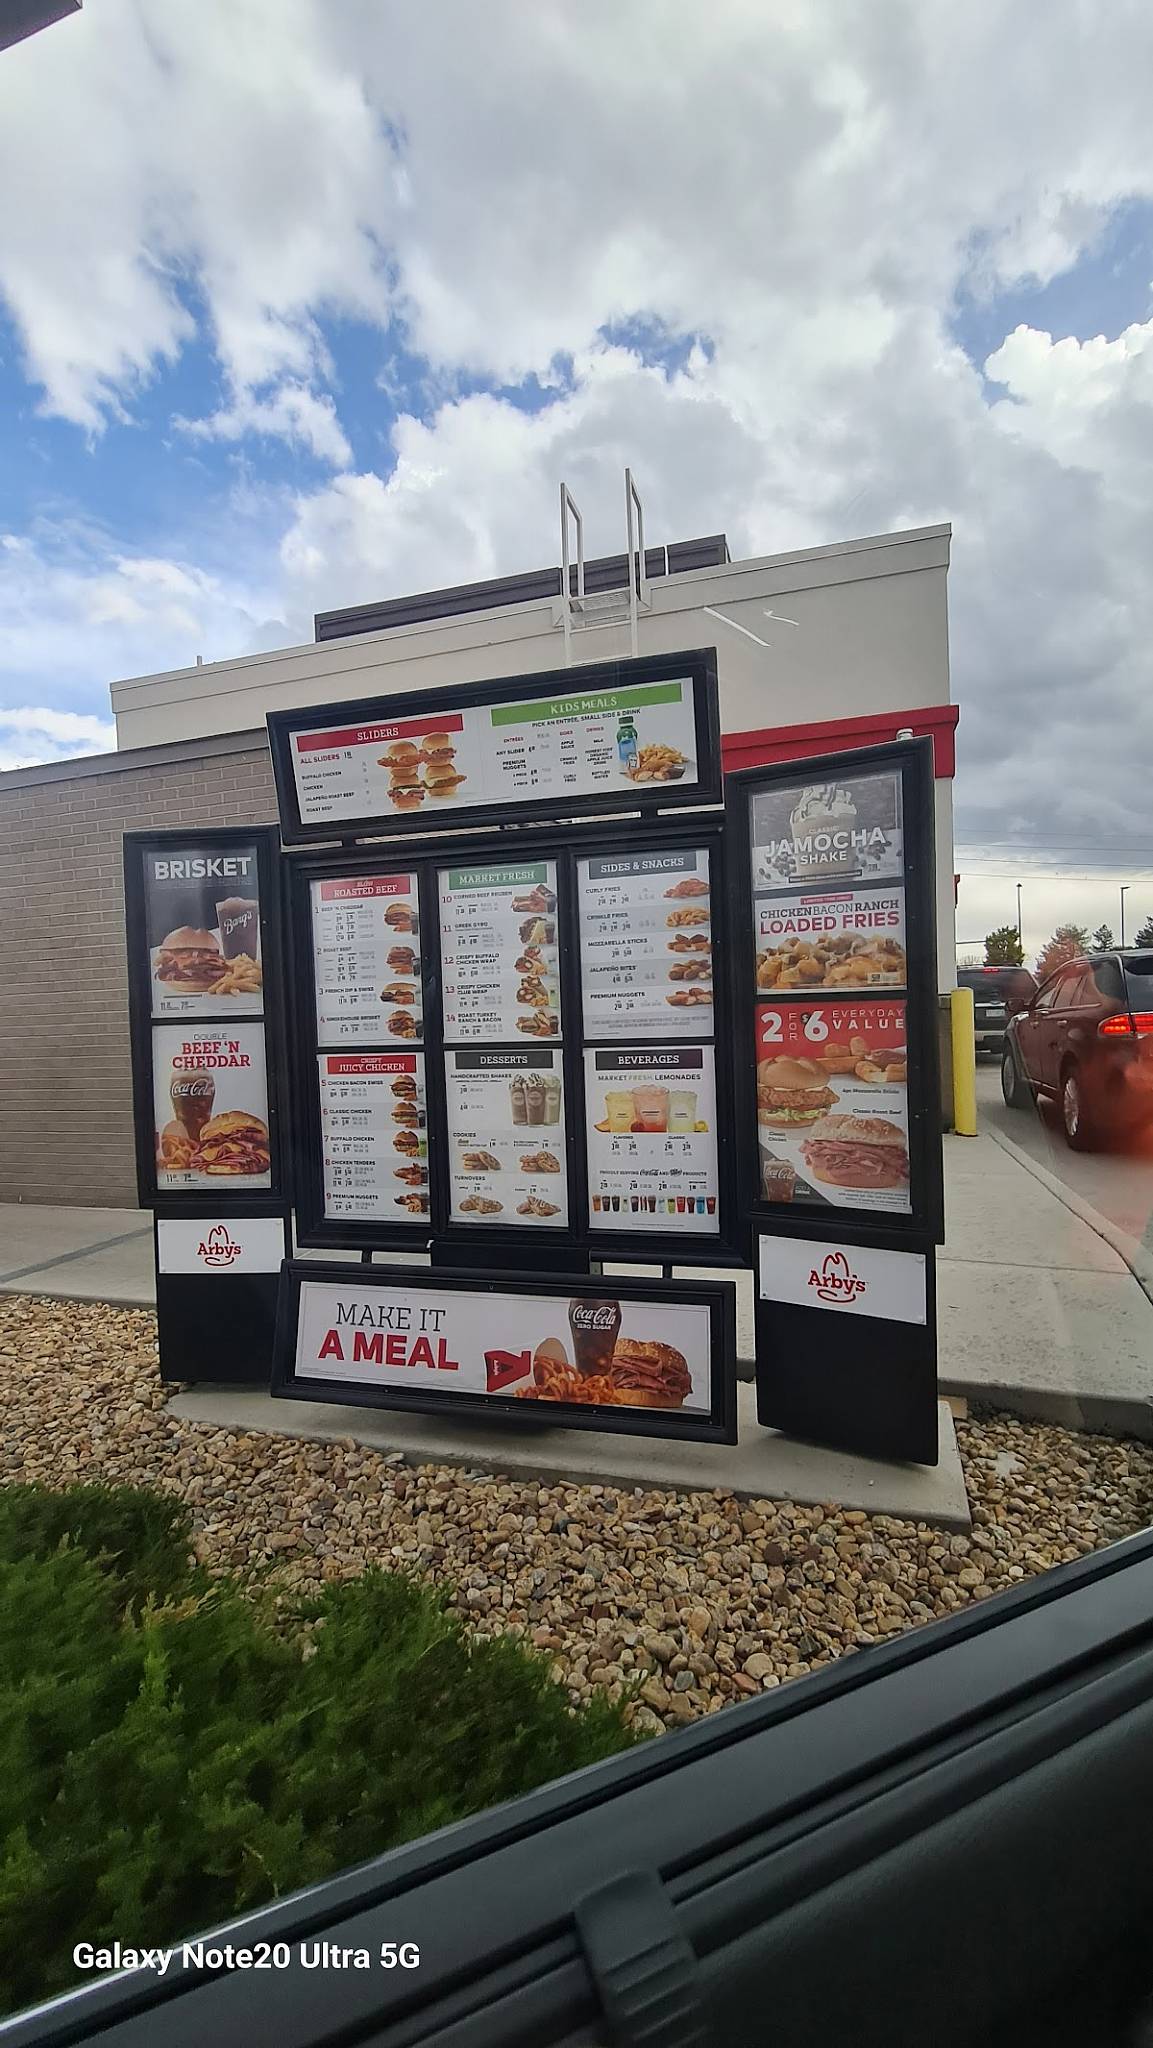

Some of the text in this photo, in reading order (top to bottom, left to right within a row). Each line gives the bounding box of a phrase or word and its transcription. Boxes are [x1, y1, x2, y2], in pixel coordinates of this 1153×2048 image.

[551, 696, 618, 714] KIDS MEALS
[357, 728, 399, 741] SLIDERS
[314, 752, 340, 762] SLIDERS
[765, 826, 886, 858] JAMOCHA
[800, 850, 848, 865] SHAKE
[154, 856, 252, 880] BRISKET
[600, 857, 684, 873] SIDES & SNACKS
[334, 884, 398, 898] ROASTED BEEF
[442, 896, 452, 904] 10
[760, 900, 900, 919] CHICKEN BACON RANCH
[760, 910, 900, 935] LOADED FRIES
[444, 956, 454, 964] 12
[446, 986, 454, 994] 13
[446, 1014, 456, 1022] 14
[832, 1008, 904, 1018] EVERYDAY
[760, 1011, 784, 1043] 2
[832, 1018, 904, 1030] VALUE
[182, 1042, 222, 1055] BEEF
[172, 1054, 251, 1068] CHEDDAR
[480, 1056, 528, 1064] DESSERTS
[618, 1055, 680, 1064] BEVERAGES
[339, 1063, 405, 1072] JUICY CHICKEN
[326, 1192, 332, 1200] 9
[197, 1242, 242, 1258] Arby's
[808, 1270, 866, 1294] Arby's
[335, 1302, 446, 1332] MAKE IT
[572, 1304, 616, 1325] Coca-Cola
[318, 1329, 345, 1361] A
[352, 1331, 460, 1370] MEAL
